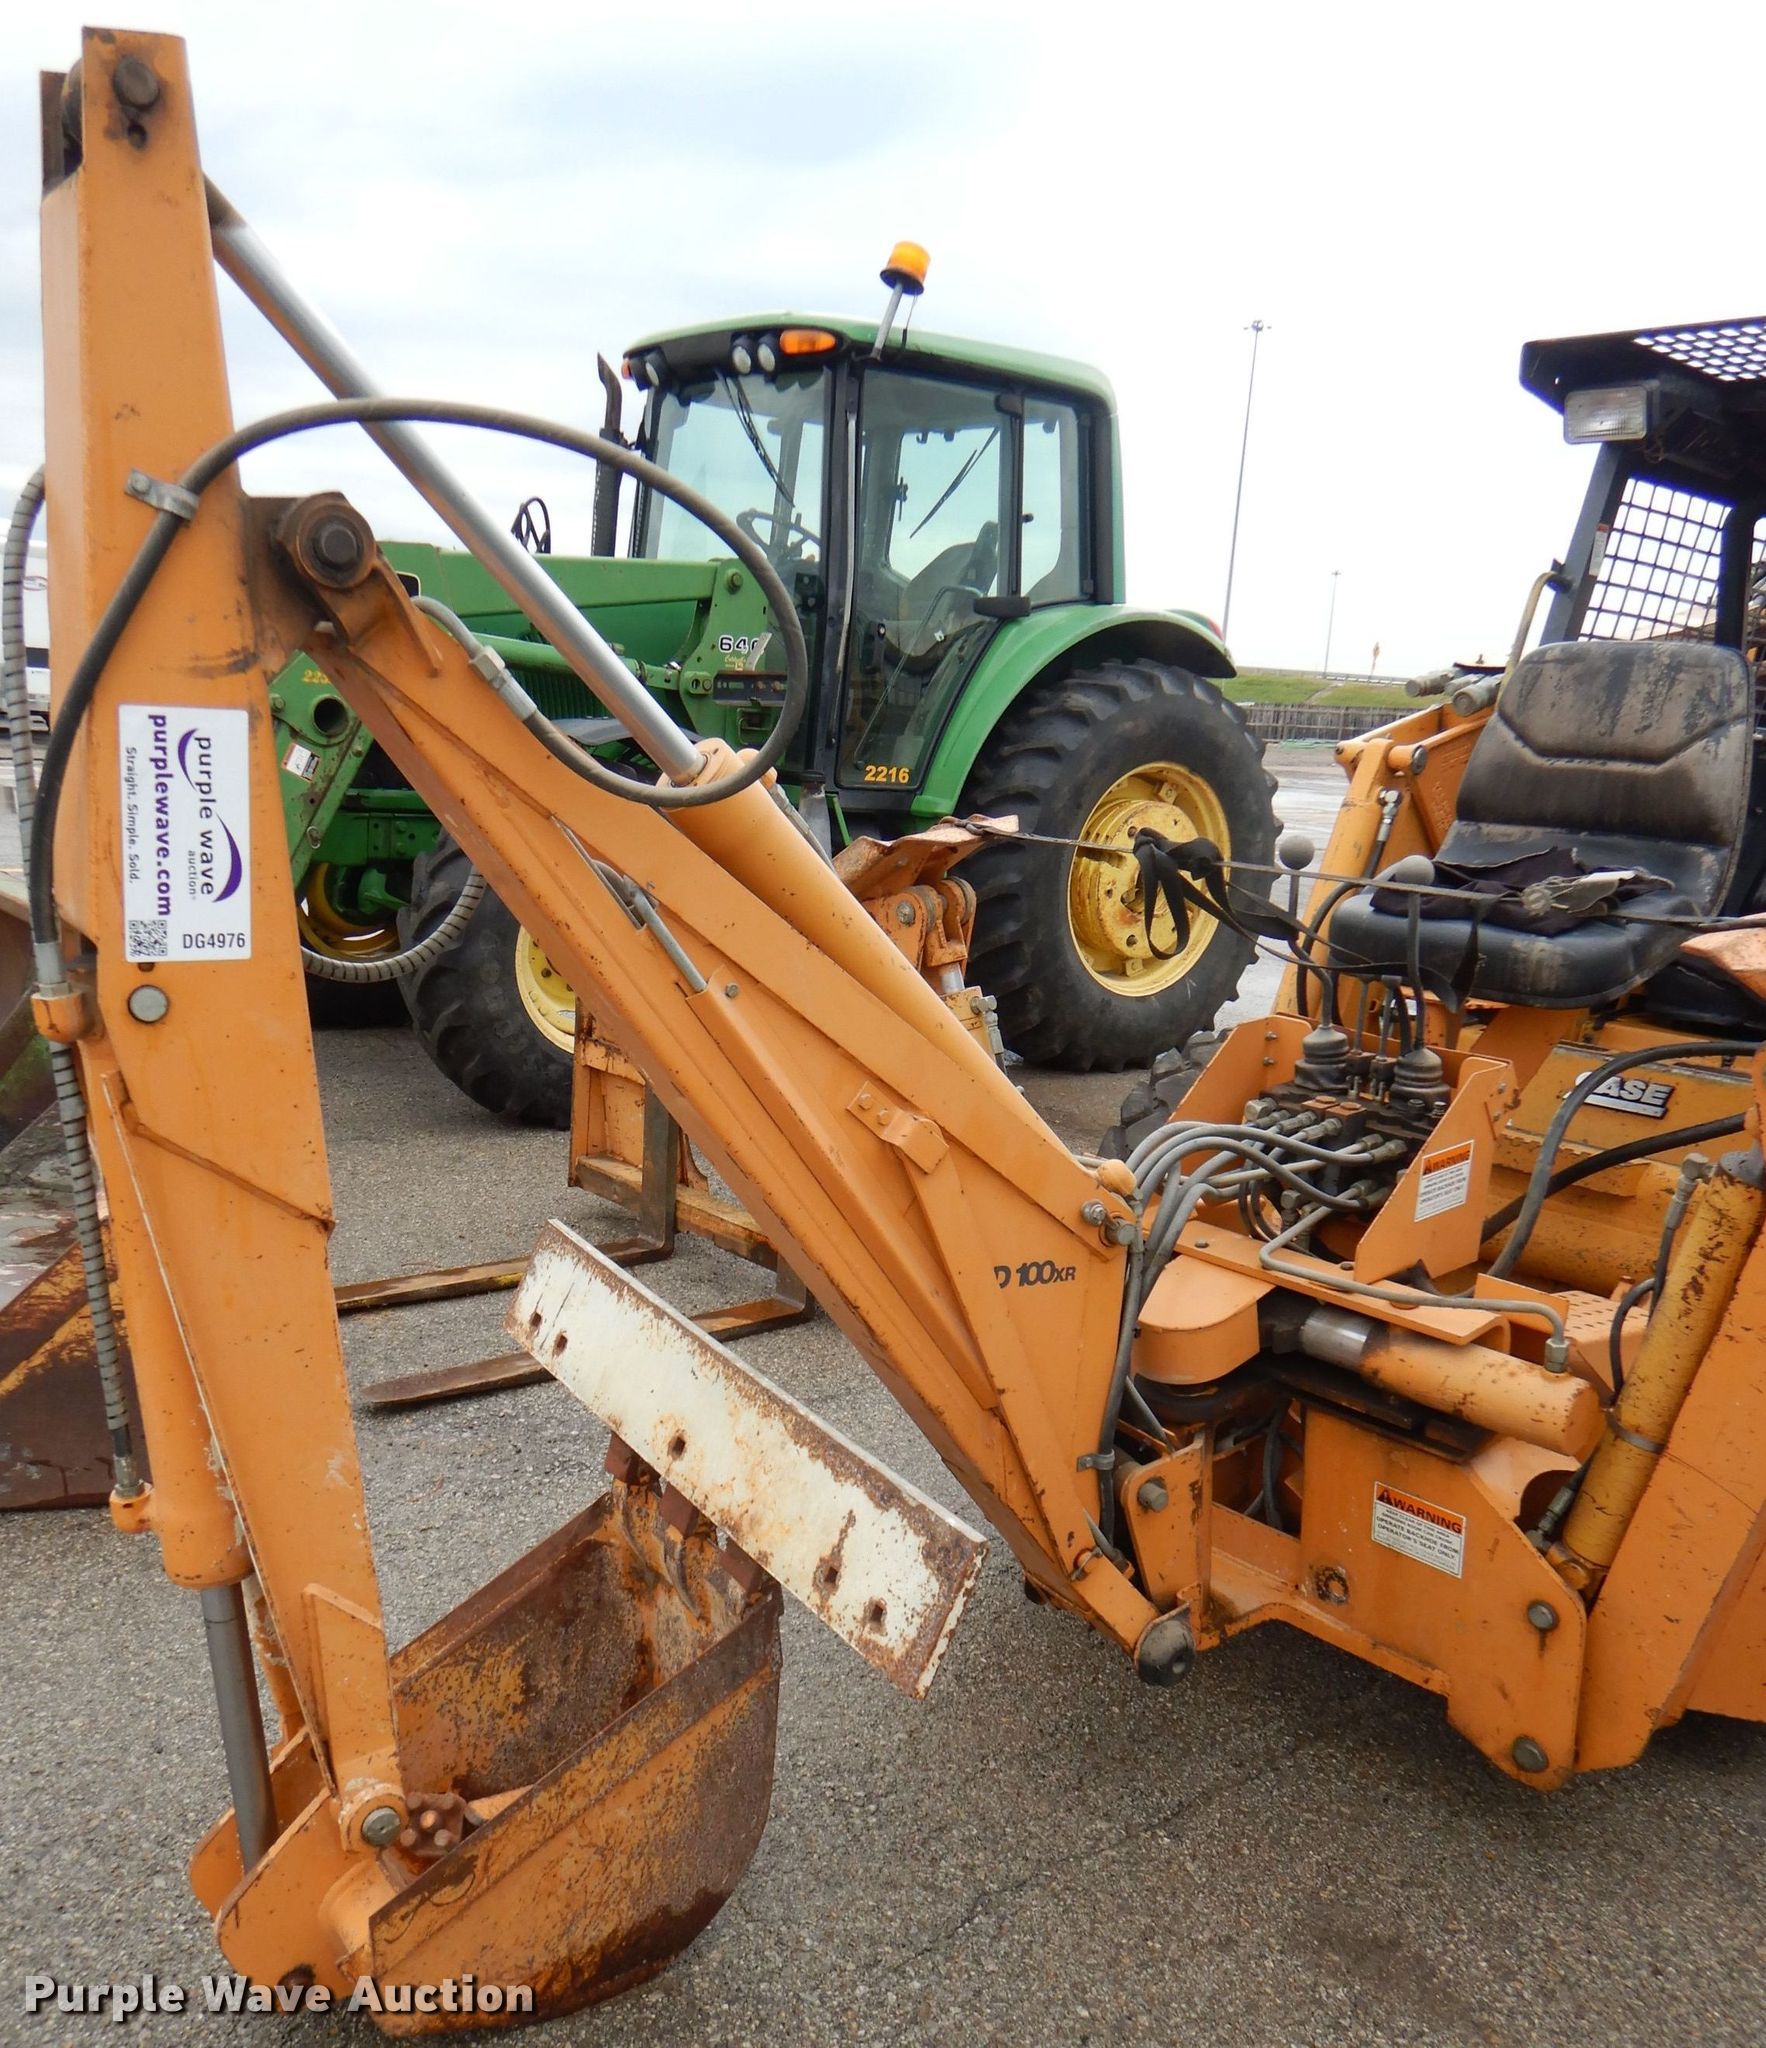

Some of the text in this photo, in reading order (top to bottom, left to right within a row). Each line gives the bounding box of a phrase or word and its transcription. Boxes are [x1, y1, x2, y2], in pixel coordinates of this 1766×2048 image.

[864, 765, 910, 783] 2216
[125, 746, 140, 884] Straight. Simple. Sold.
[148, 714, 174, 916] purplewave.com
[194, 736, 216, 896] purple wave
[187, 849, 197, 896] auction
[182, 933, 246, 949] DG4976
[1392, 1498, 1463, 1535] WARNING
